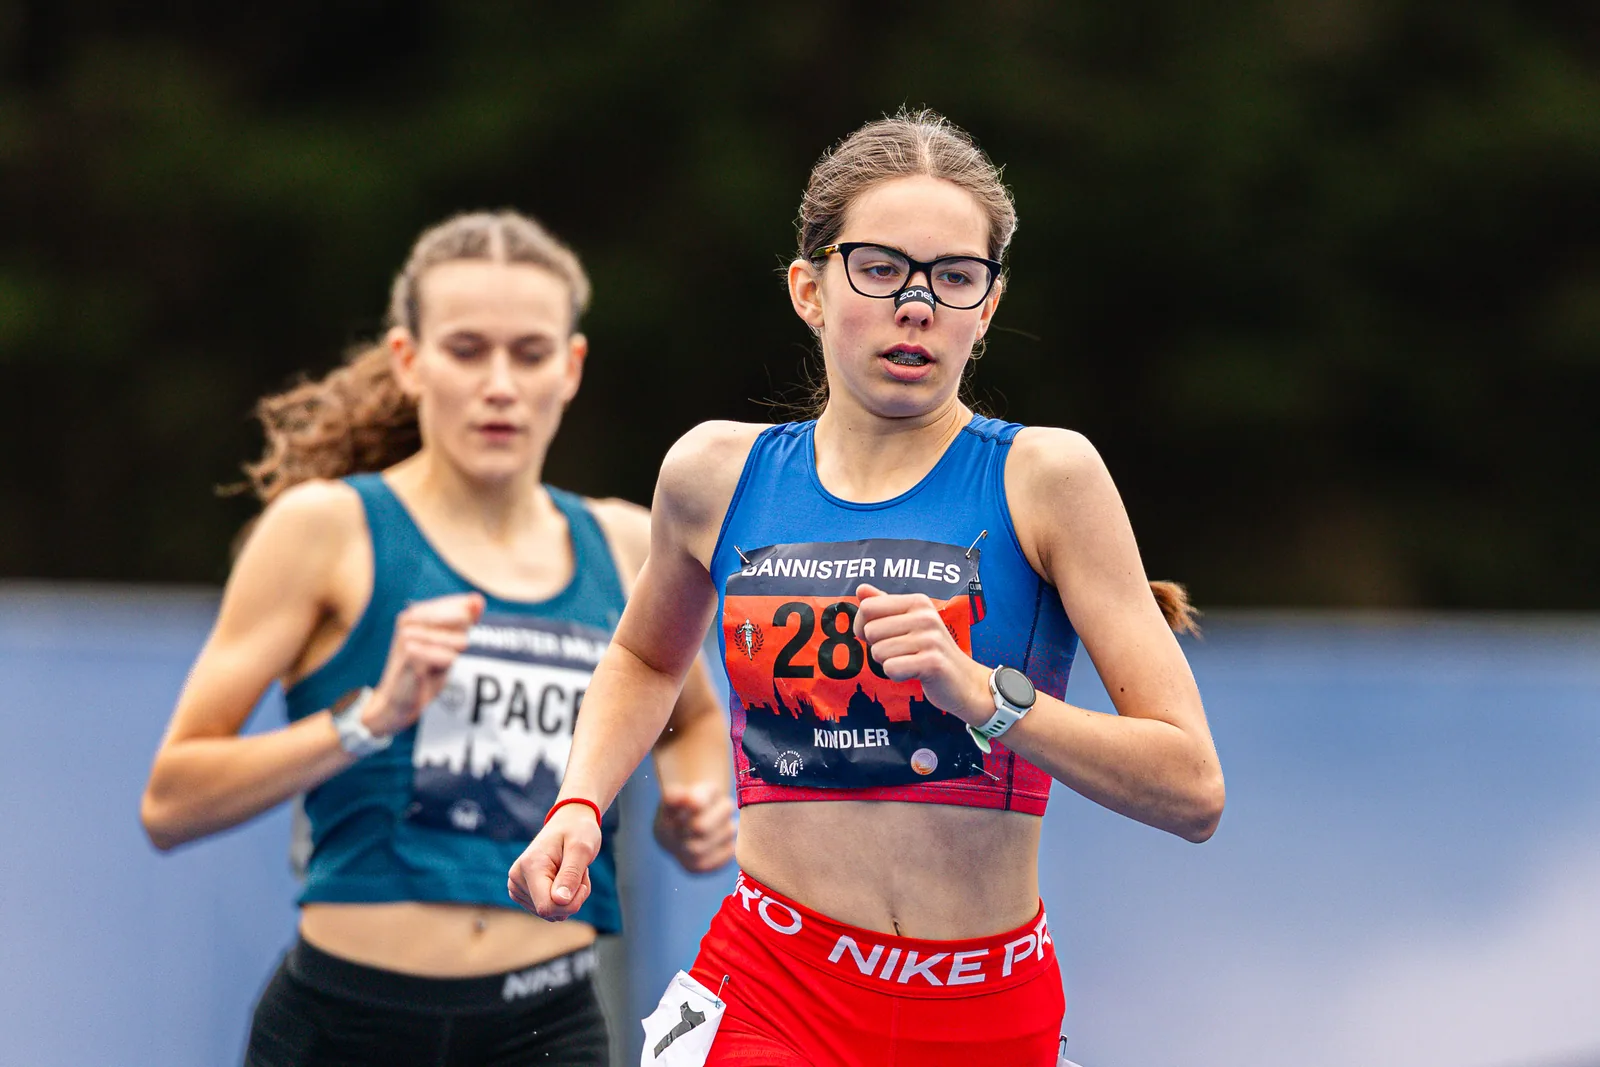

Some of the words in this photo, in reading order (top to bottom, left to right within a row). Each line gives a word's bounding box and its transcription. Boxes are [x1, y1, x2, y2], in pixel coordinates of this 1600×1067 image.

[883, 558, 961, 584] MILES
[813, 728, 890, 749] KINDLER
[827, 934, 990, 986] NIKE
[1002, 912, 1051, 977] PR
